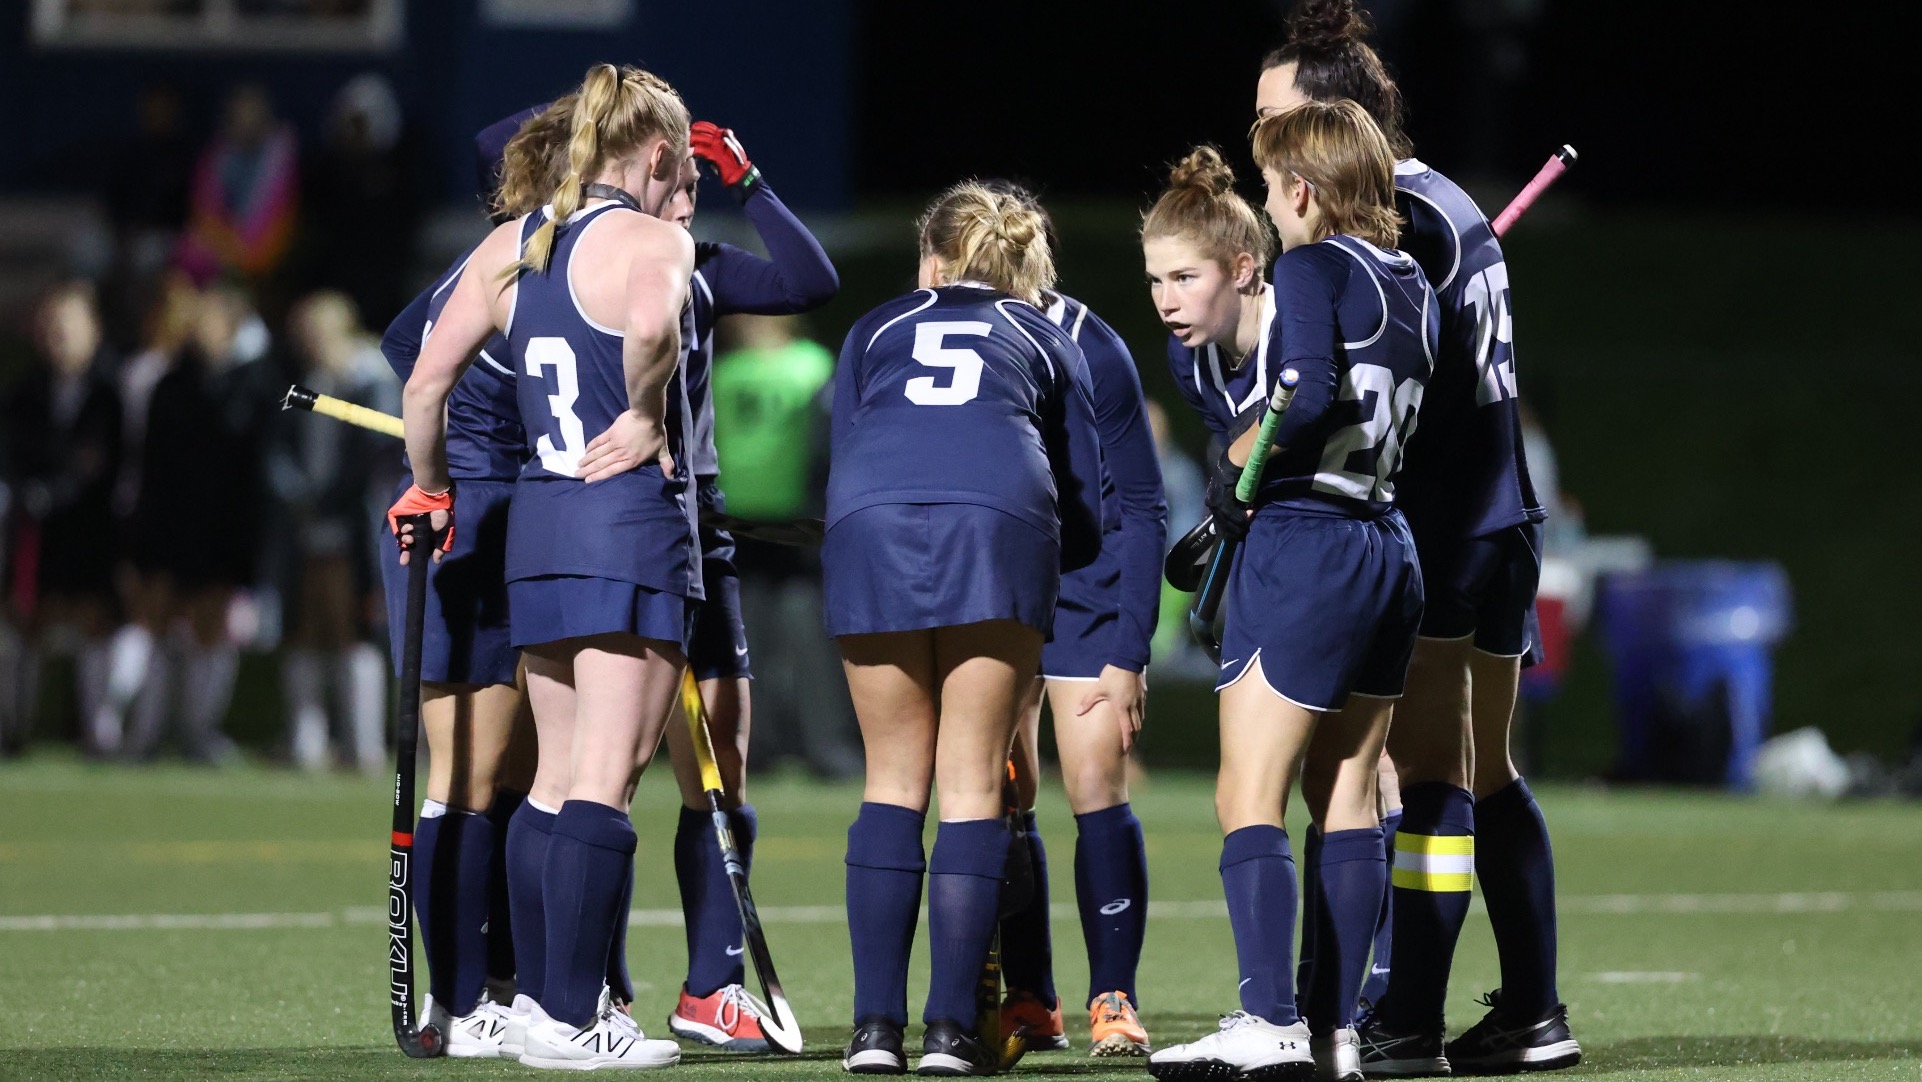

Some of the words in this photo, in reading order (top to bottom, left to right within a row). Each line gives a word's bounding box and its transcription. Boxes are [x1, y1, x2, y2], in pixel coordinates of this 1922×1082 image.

[525, 336, 586, 478] 3
[904, 321, 993, 406] 5
[1311, 362, 1424, 502] 20
